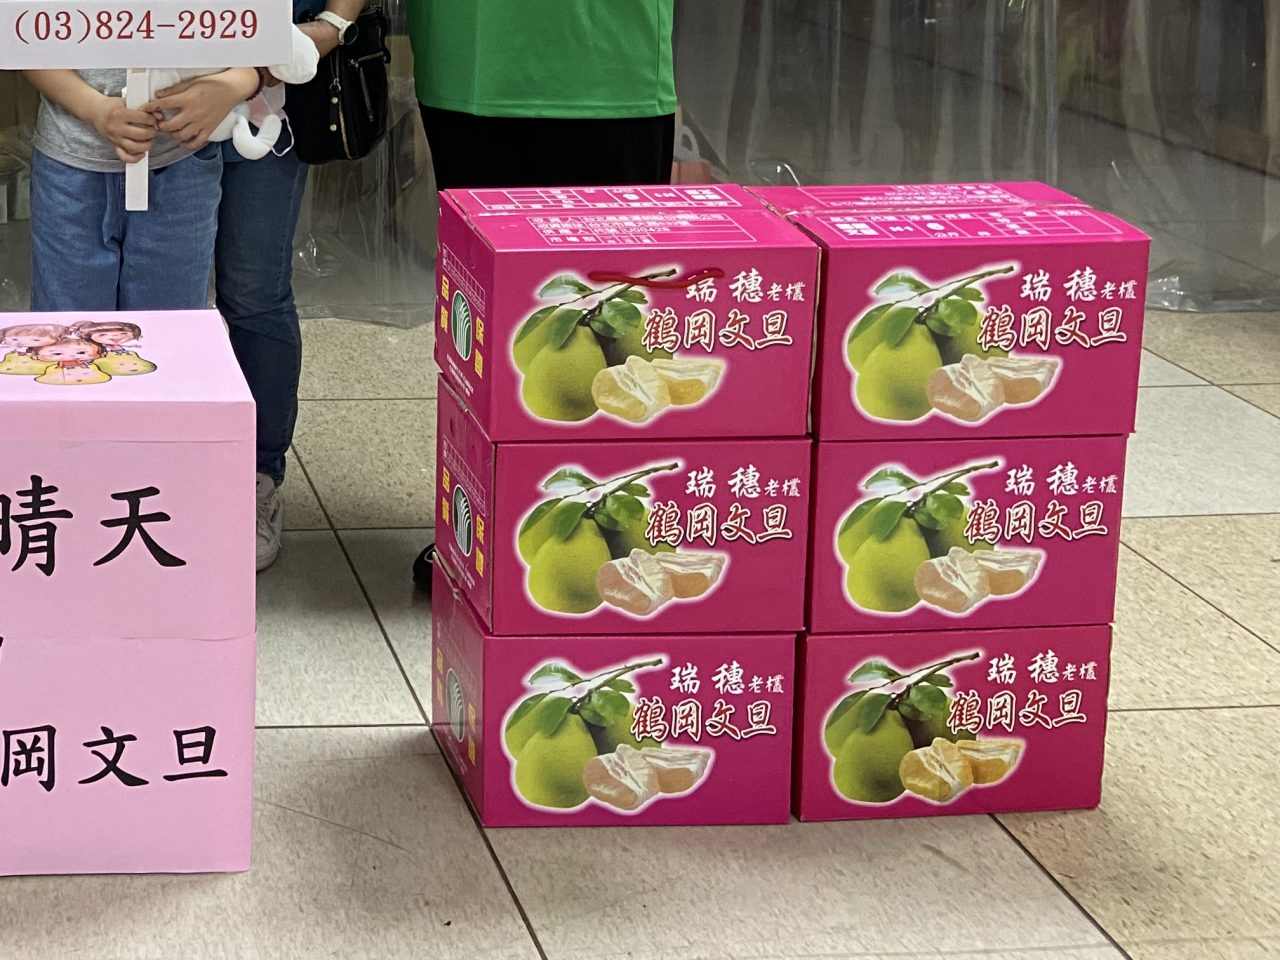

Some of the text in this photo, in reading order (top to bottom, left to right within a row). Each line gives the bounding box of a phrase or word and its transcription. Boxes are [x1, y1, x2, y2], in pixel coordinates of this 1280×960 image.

[15, 9, 259, 45] (03)824-2929
[641, 308, 793, 354] 鶴岡文旦
[978, 305, 1126, 352] 鶴岡文旦
[645, 500, 794, 546] 鶴岡文旦
[963, 499, 1108, 544] 鶴岡文旦
[630, 696, 777, 743] 鶴岡文旦
[947, 689, 1087, 735] 鶴岡文旦
